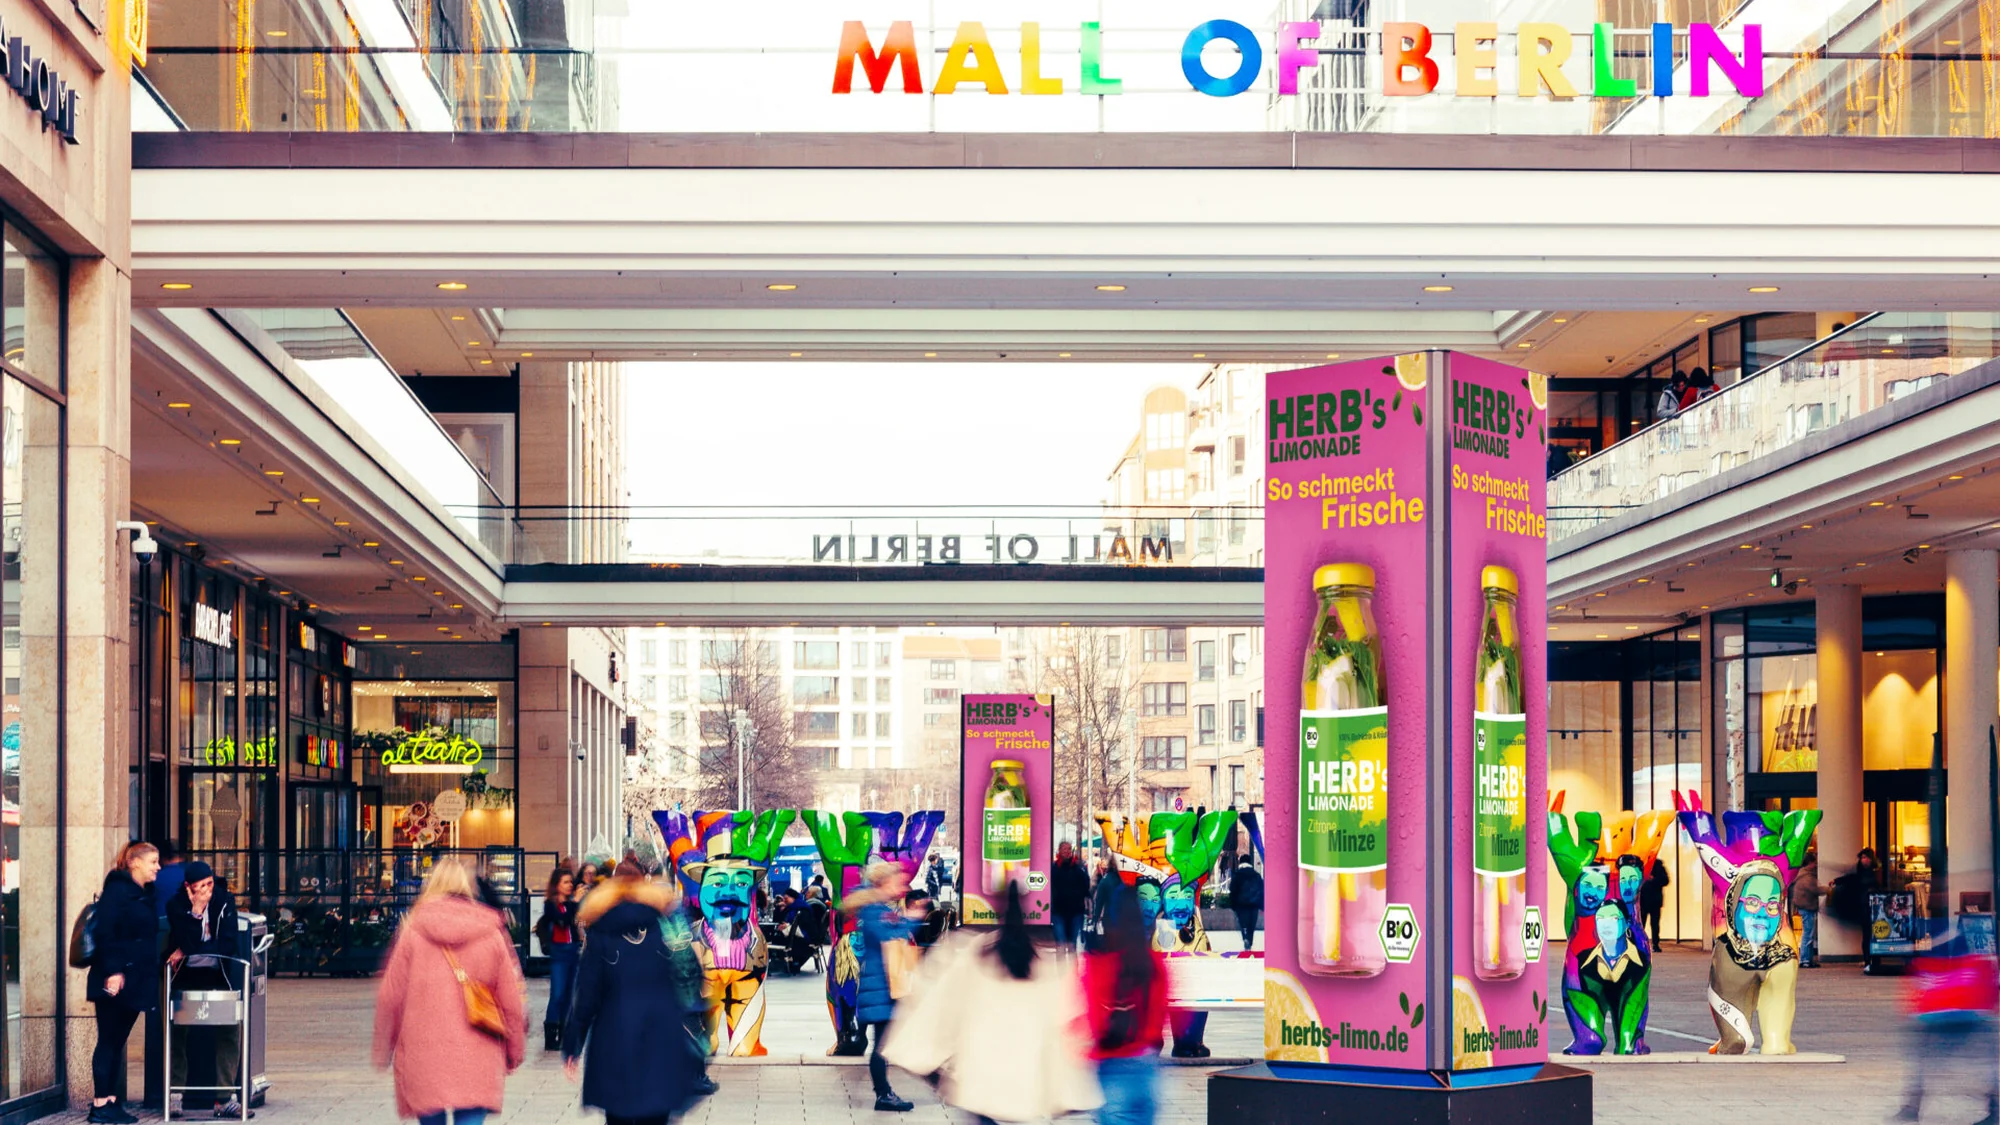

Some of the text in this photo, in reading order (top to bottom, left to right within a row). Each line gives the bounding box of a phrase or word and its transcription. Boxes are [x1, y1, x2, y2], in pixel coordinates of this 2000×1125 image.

[832, 18, 1765, 98] MALL OF BERLIN
[1268, 388, 1387, 440] HERB's
[1453, 379, 1525, 440] HERB's
[1269, 434, 1361, 464] LIMONADE
[1453, 426, 1510, 459] LIMONADE
[1268, 467, 1395, 501] So schmeckt
[1453, 464, 1530, 502] So schmeckt
[1321, 492, 1425, 530] Frische
[1486, 496, 1547, 539] Frische
[966, 702, 1031, 718] HERB's
[967, 717, 1017, 725] LIMONADE
[966, 729, 1035, 739] So schmeckt
[995, 737, 1051, 749] Frische
[1307, 759, 1388, 794] HERB's
[1307, 794, 1375, 811] LIMONADE
[1479, 798, 1519, 815] LIMONADE
[1328, 829, 1376, 852] Minze
[1492, 833, 1520, 857] Minze
[1281, 1019, 1409, 1052] herbs-limo.de
[1463, 1022, 1539, 1053] herbs-limo.de
